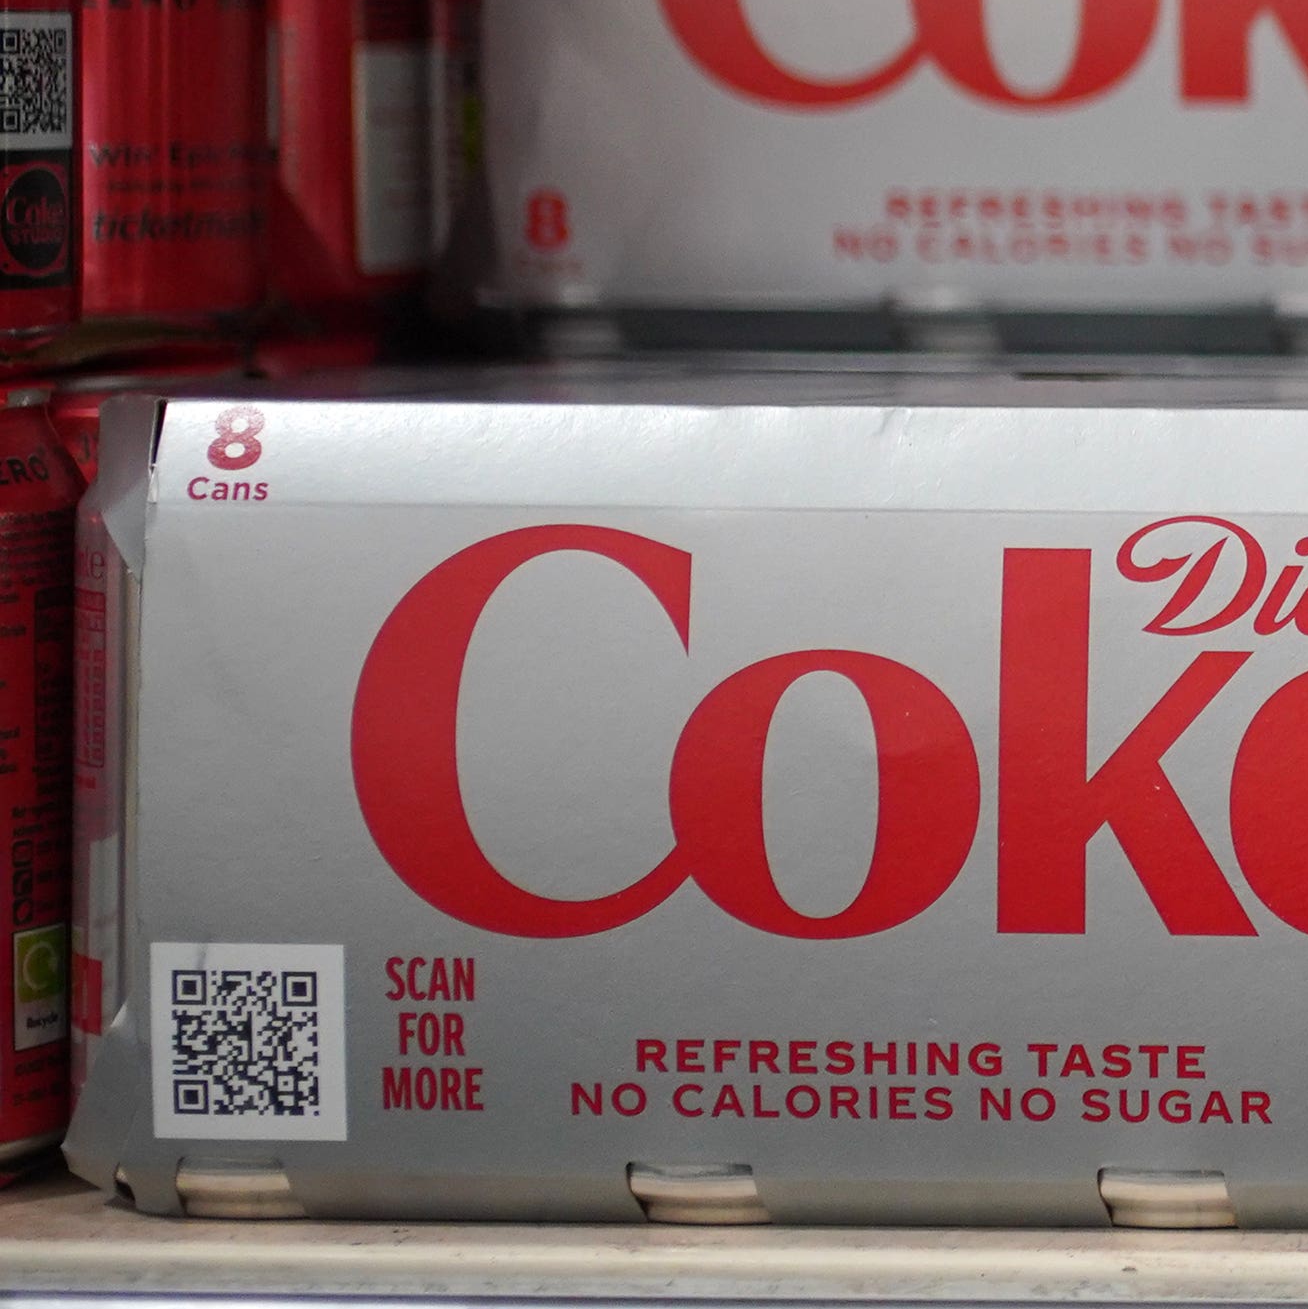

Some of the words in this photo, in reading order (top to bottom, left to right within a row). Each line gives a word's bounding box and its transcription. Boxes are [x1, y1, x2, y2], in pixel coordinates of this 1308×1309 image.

[884, 192, 1187, 226] REFRESHING
[831, 229, 895, 262] NO
[916, 229, 1149, 264] CALORIES
[1167, 230, 1233, 262] NO
[207, 405, 264, 471] 8
[188, 476, 269, 502] Cans
[386, 957, 476, 1001] SCAN
[400, 1012, 465, 1055] FOR
[637, 1040, 1003, 1078] REFRESHING
[1028, 1044, 1206, 1080] TASTE
[382, 1067, 484, 1111] MORE
[571, 1082, 648, 1117] NO
[673, 1083, 953, 1121] CALORIES
[981, 1087, 1056, 1121] NO
[1082, 1088, 1272, 1125] SUGAR
